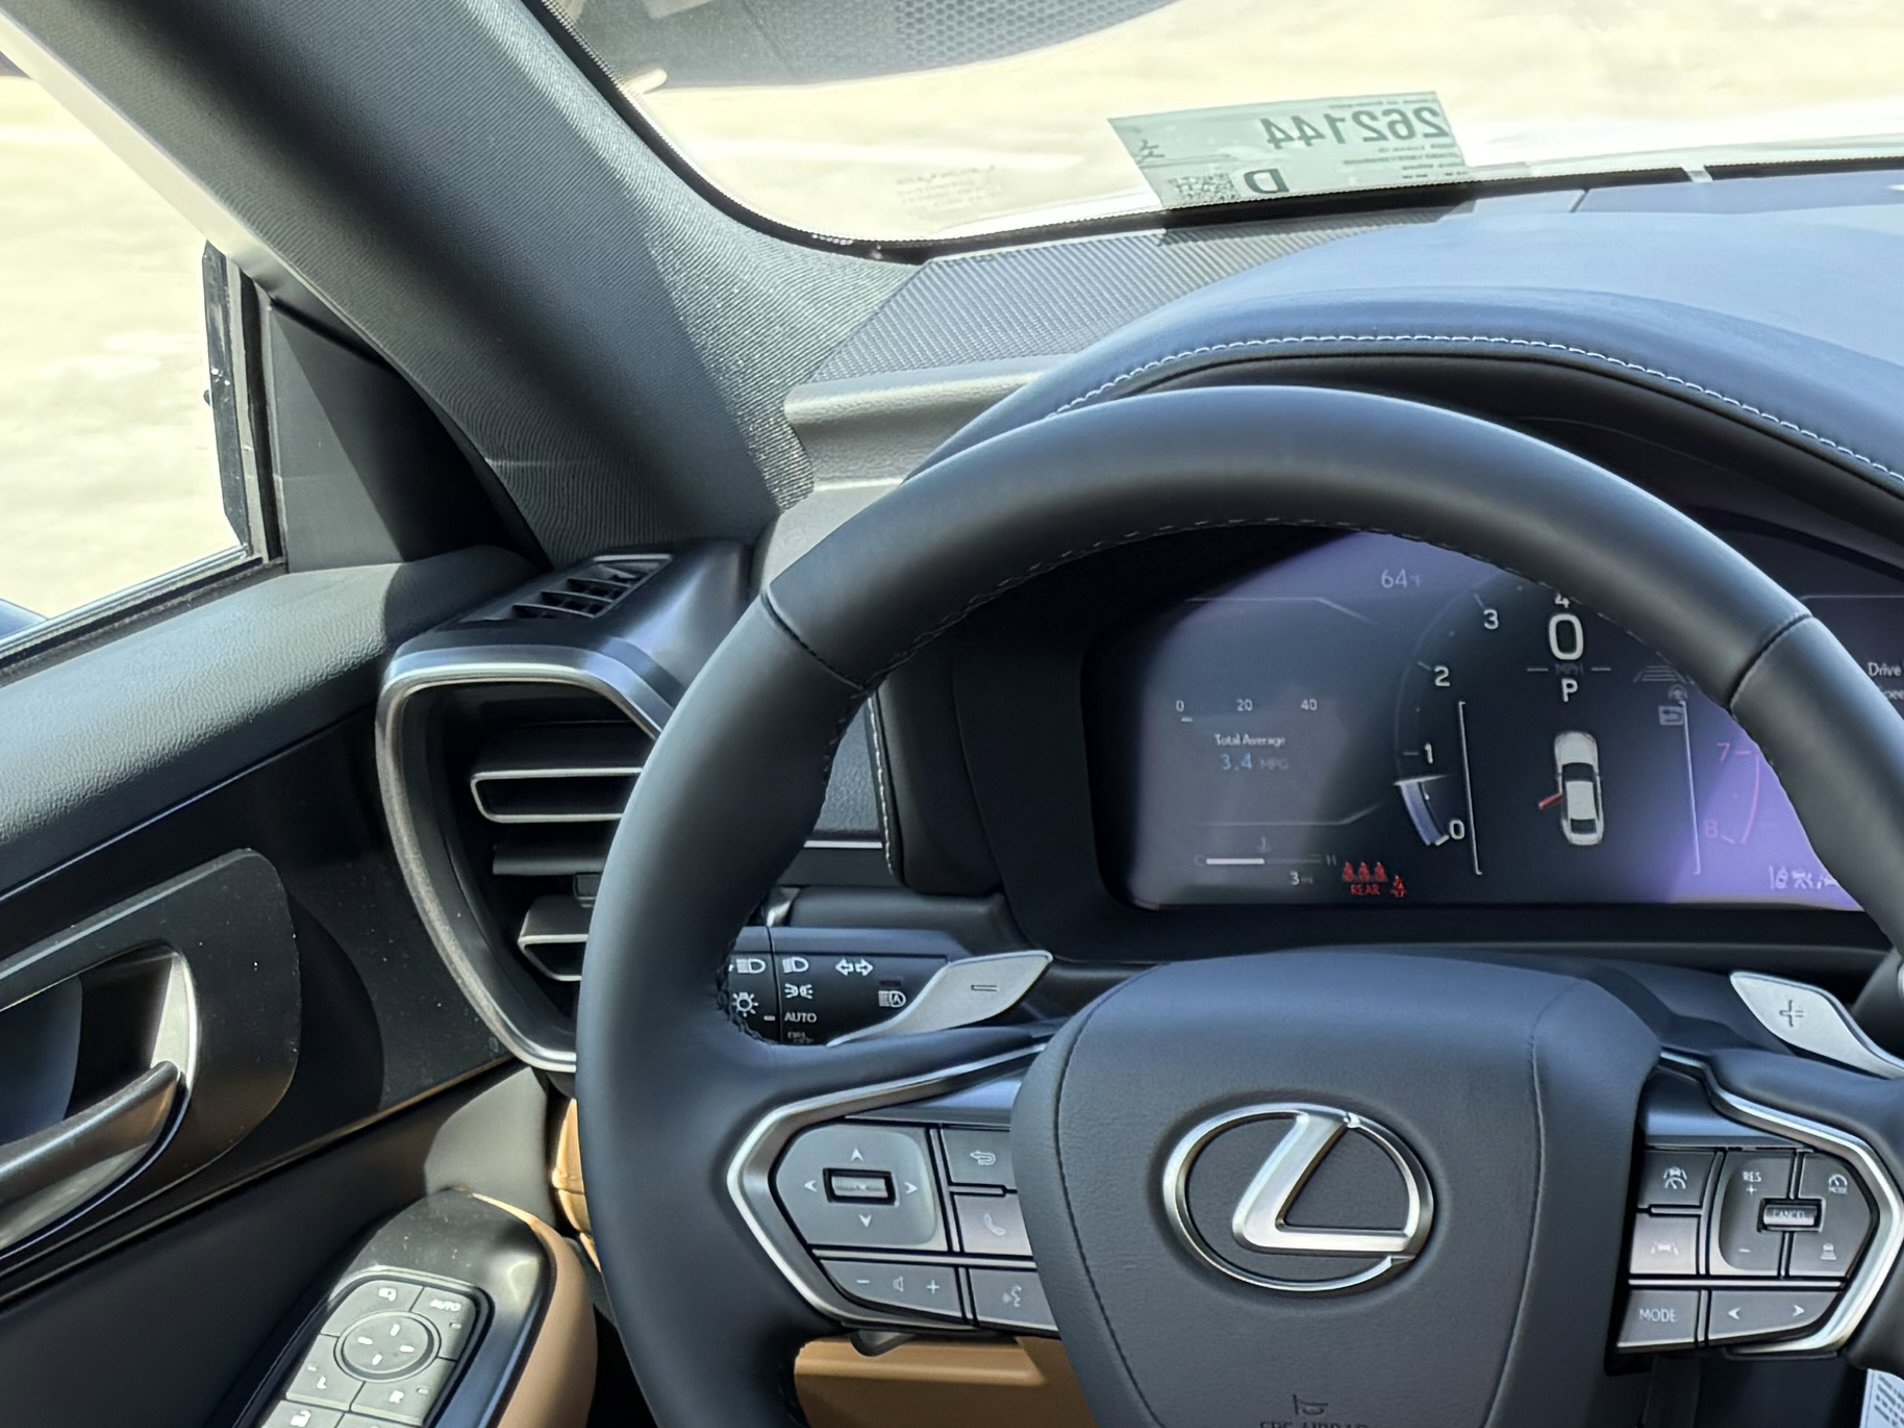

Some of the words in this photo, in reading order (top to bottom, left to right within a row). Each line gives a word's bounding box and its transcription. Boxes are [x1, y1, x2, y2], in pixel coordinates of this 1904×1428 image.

[1483, 608, 1499, 630] 3
[1548, 613, 1584, 661] 0
[1434, 666, 1450, 687] 2
[1868, 662, 1901, 677] Drive
[1561, 678, 1578, 702] P
[1176, 700, 1185, 712] 0
[1236, 699, 1253, 712] 20
[1301, 699, 1317, 712] 40
[1215, 733, 1240, 746] Total
[1424, 742, 1434, 764] 1
[1220, 754, 1252, 770] 3.4
[1449, 818, 1465, 840] 0
[784, 1011, 817, 1023] AUTO
[1742, 1171, 1762, 1183] RES
[430, 1300, 461, 1311] AUTO
[1639, 1308, 1676, 1323] MODE
